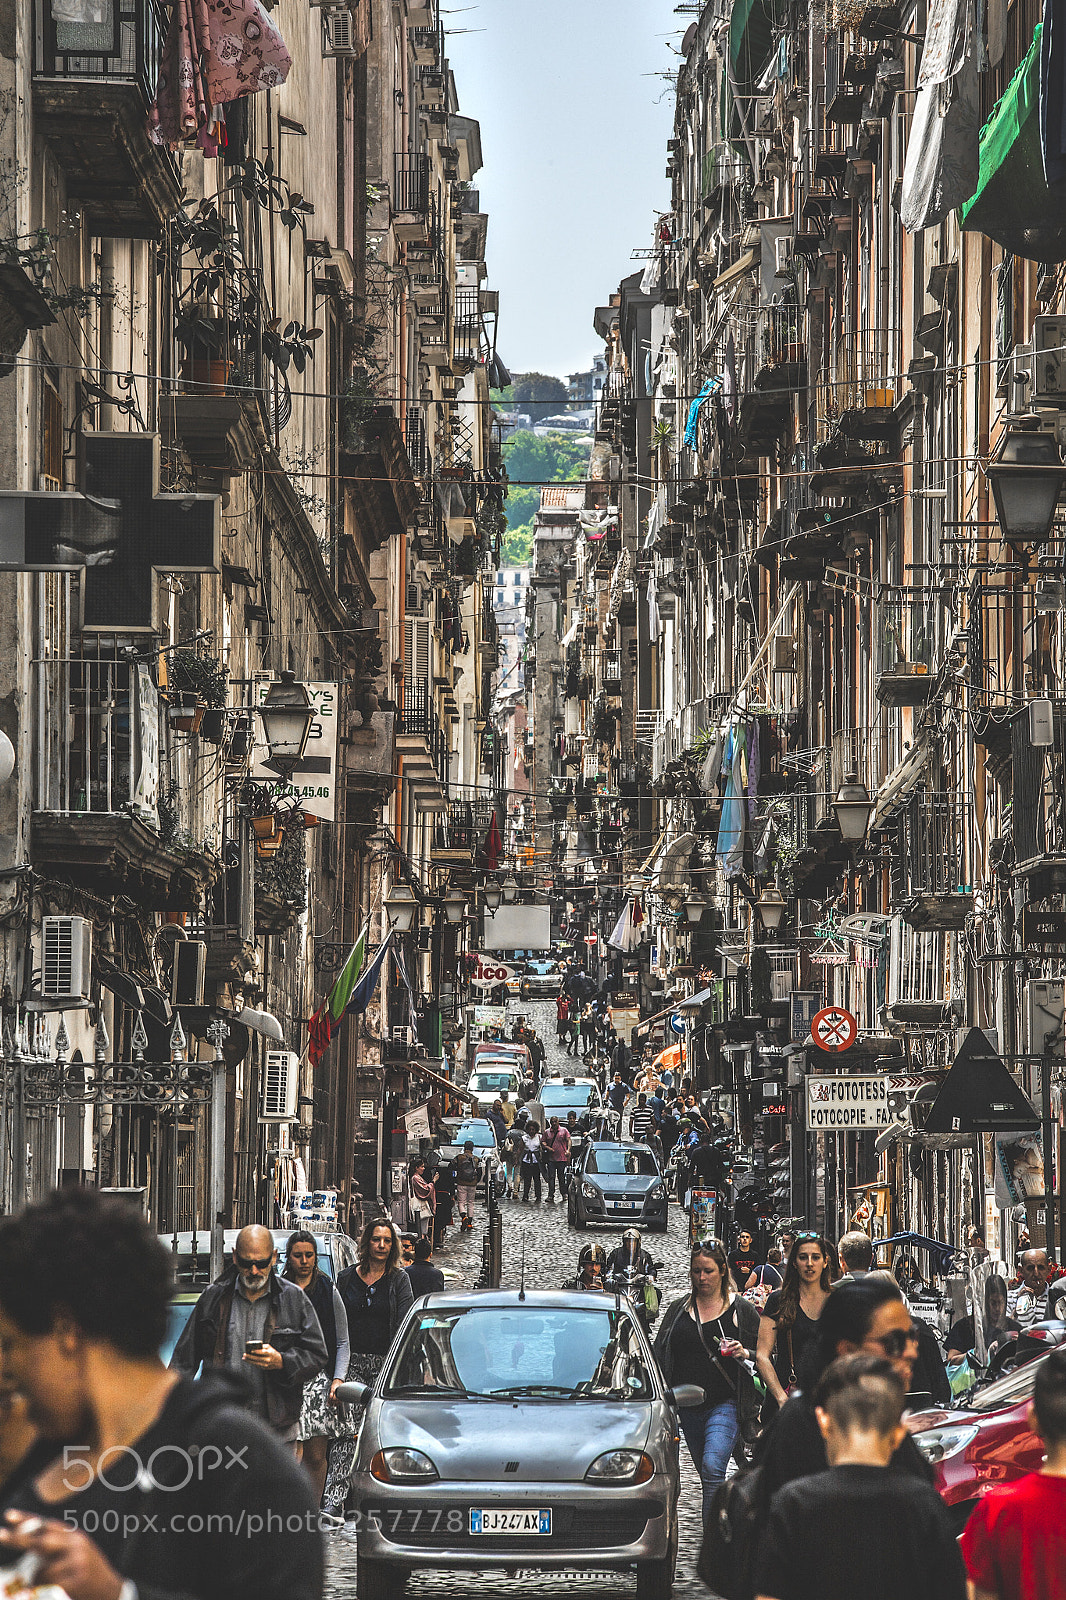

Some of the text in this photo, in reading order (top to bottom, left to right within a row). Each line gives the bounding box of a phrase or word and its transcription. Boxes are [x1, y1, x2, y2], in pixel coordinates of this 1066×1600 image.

[831, 1081, 886, 1101] FOTOTESS
[811, 1109, 866, 1125] FOTOCOPIE
[876, 1108, 894, 1124] FAX
